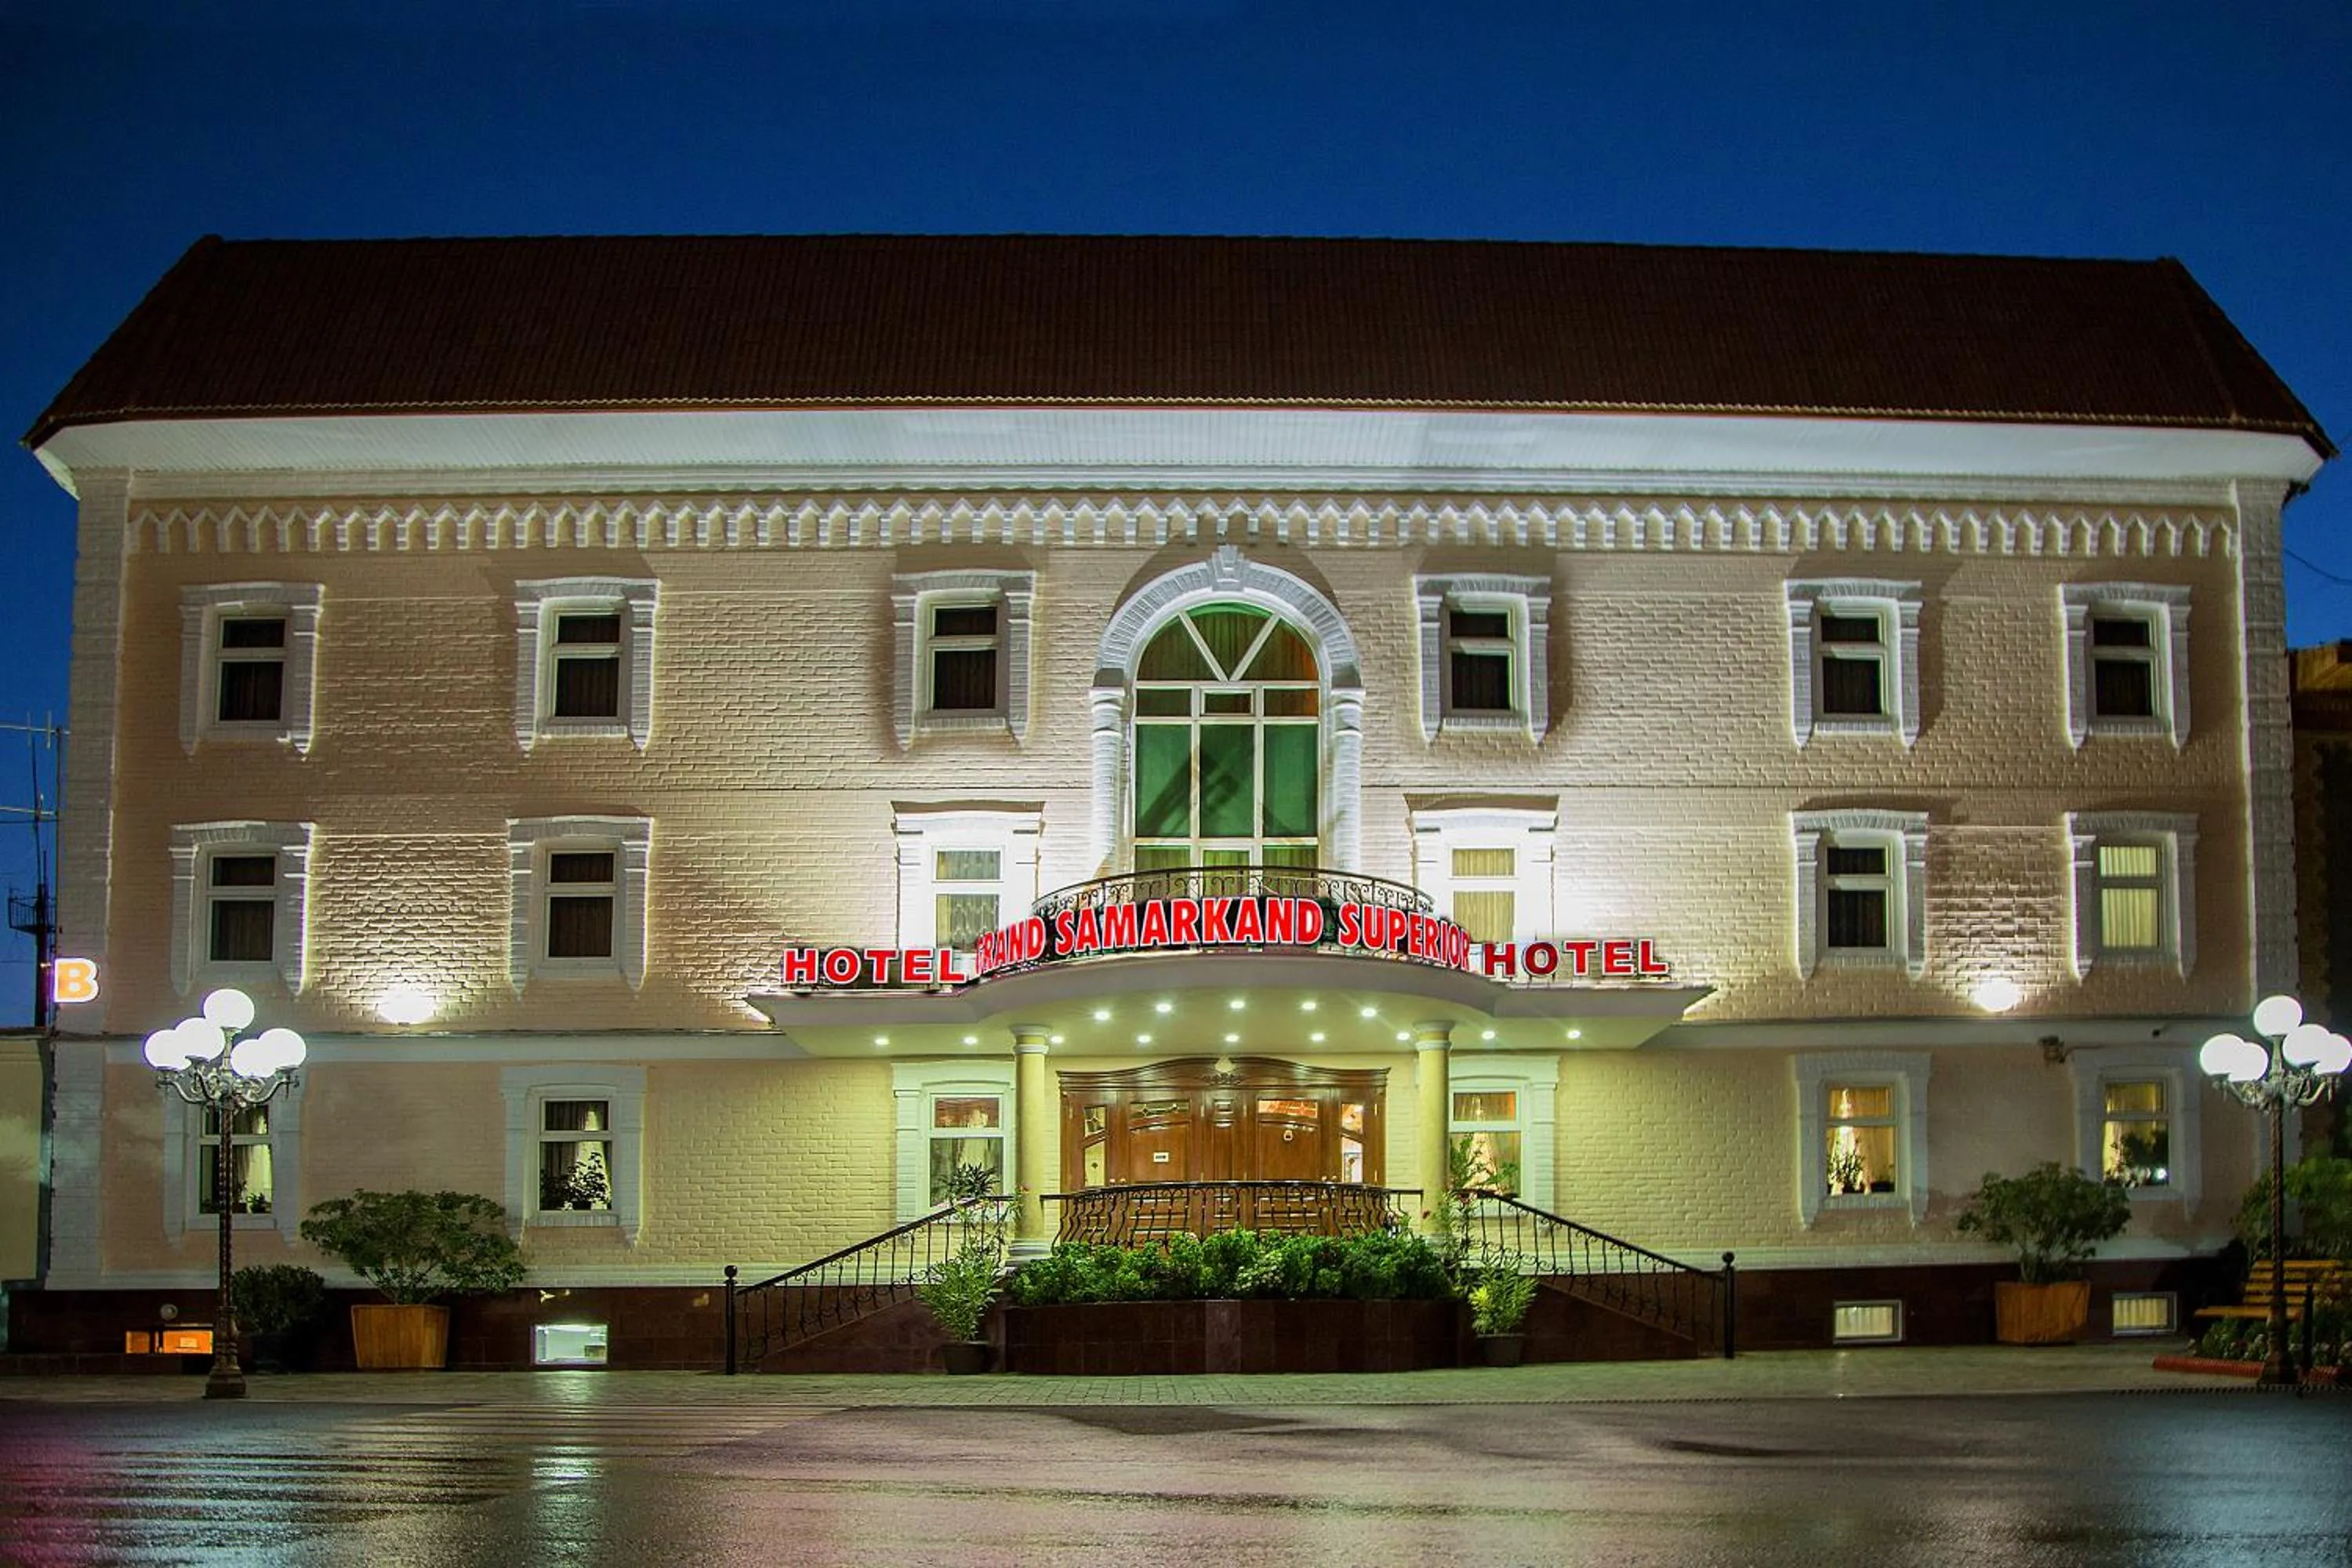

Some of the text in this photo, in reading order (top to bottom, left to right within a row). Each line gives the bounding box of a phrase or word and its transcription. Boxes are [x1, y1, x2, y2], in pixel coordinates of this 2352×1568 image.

[1055, 897, 1323, 955] SAMARKAND
[1338, 902, 1472, 971] SUPERIOR
[54, 957, 100, 1002] B
[784, 948, 967, 983] HOTEL
[1484, 940, 1669, 978] HOTEL
